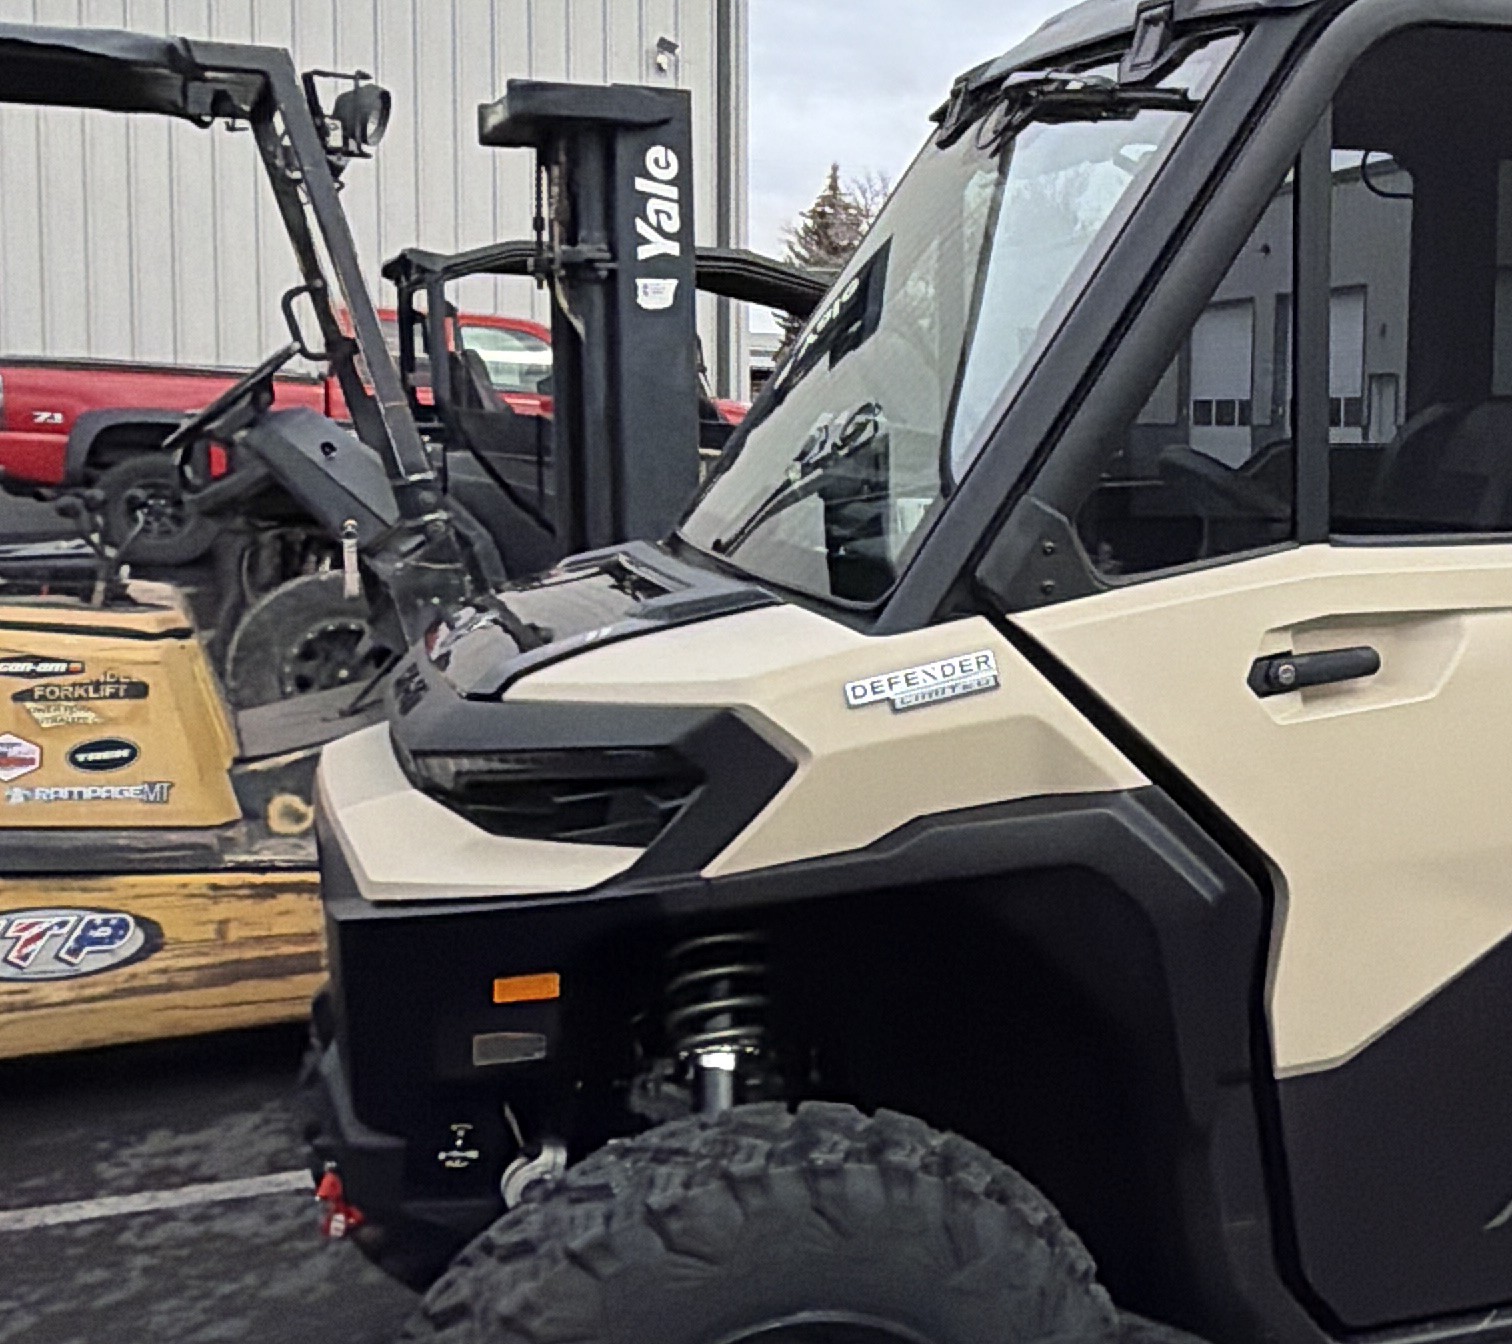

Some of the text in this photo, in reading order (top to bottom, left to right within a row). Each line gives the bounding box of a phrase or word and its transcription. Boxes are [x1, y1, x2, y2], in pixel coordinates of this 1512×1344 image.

[634, 145, 681, 260] Yale
[33, 684, 128, 700] FORKLIFT
[850, 654, 992, 700] DEFENDER
[0, 913, 136, 967] TP
